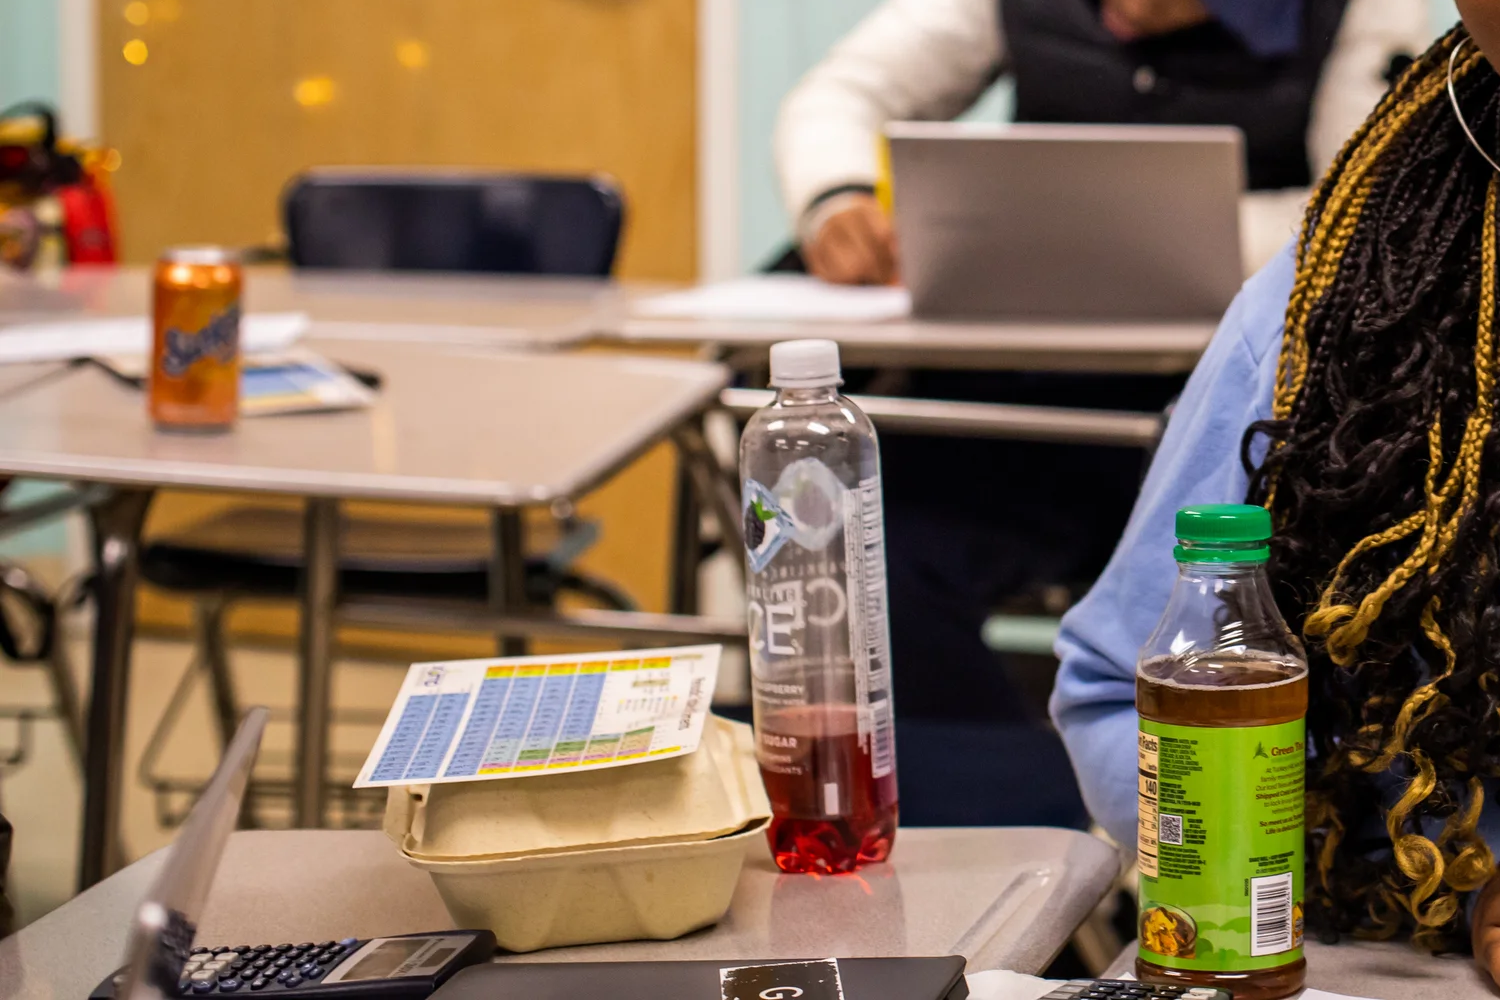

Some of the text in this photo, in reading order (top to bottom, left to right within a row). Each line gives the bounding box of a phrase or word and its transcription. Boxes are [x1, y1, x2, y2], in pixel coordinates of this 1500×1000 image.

[748, 600, 796, 655] CE
[1271, 746, 1295, 756] Green
[1145, 779, 1157, 795] 140
